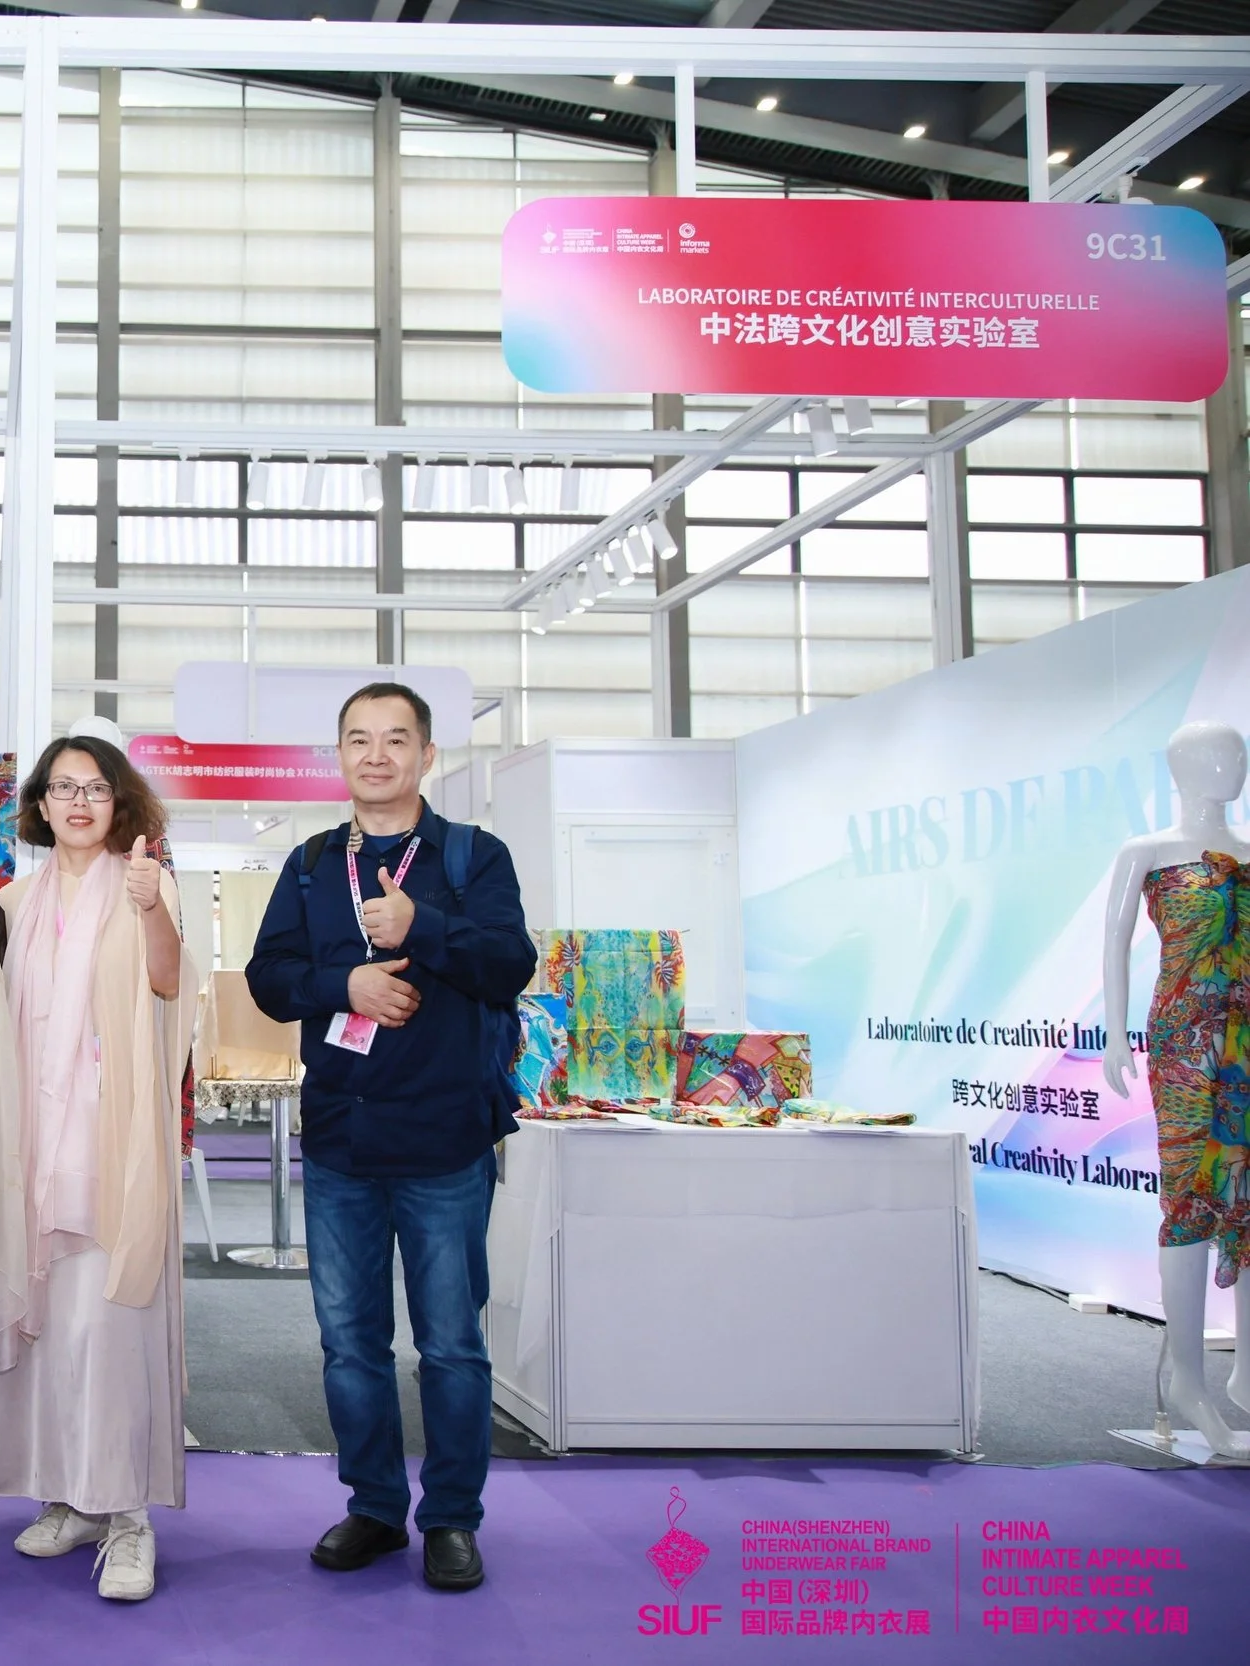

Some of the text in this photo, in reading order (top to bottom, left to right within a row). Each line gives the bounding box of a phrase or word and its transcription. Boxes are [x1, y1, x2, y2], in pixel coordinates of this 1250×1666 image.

[1086, 232, 1167, 261] 9C31
[638, 286, 1100, 311] LABORATOIRE DE CRÉATIVITÉ INTERCULTURELLE
[700, 312, 1040, 348] 中法跨文化创意实验室
[305, 768, 342, 779] FASLIN
[867, 1016, 953, 1044] Laboratoire
[956, 1018, 976, 1045] de
[980, 1018, 1067, 1049] Creativité
[952, 1079, 1100, 1121] 跨文化创意实验室
[991, 1142, 1078, 1186] Creativity
[1081, 1155, 1160, 1195] Labora
